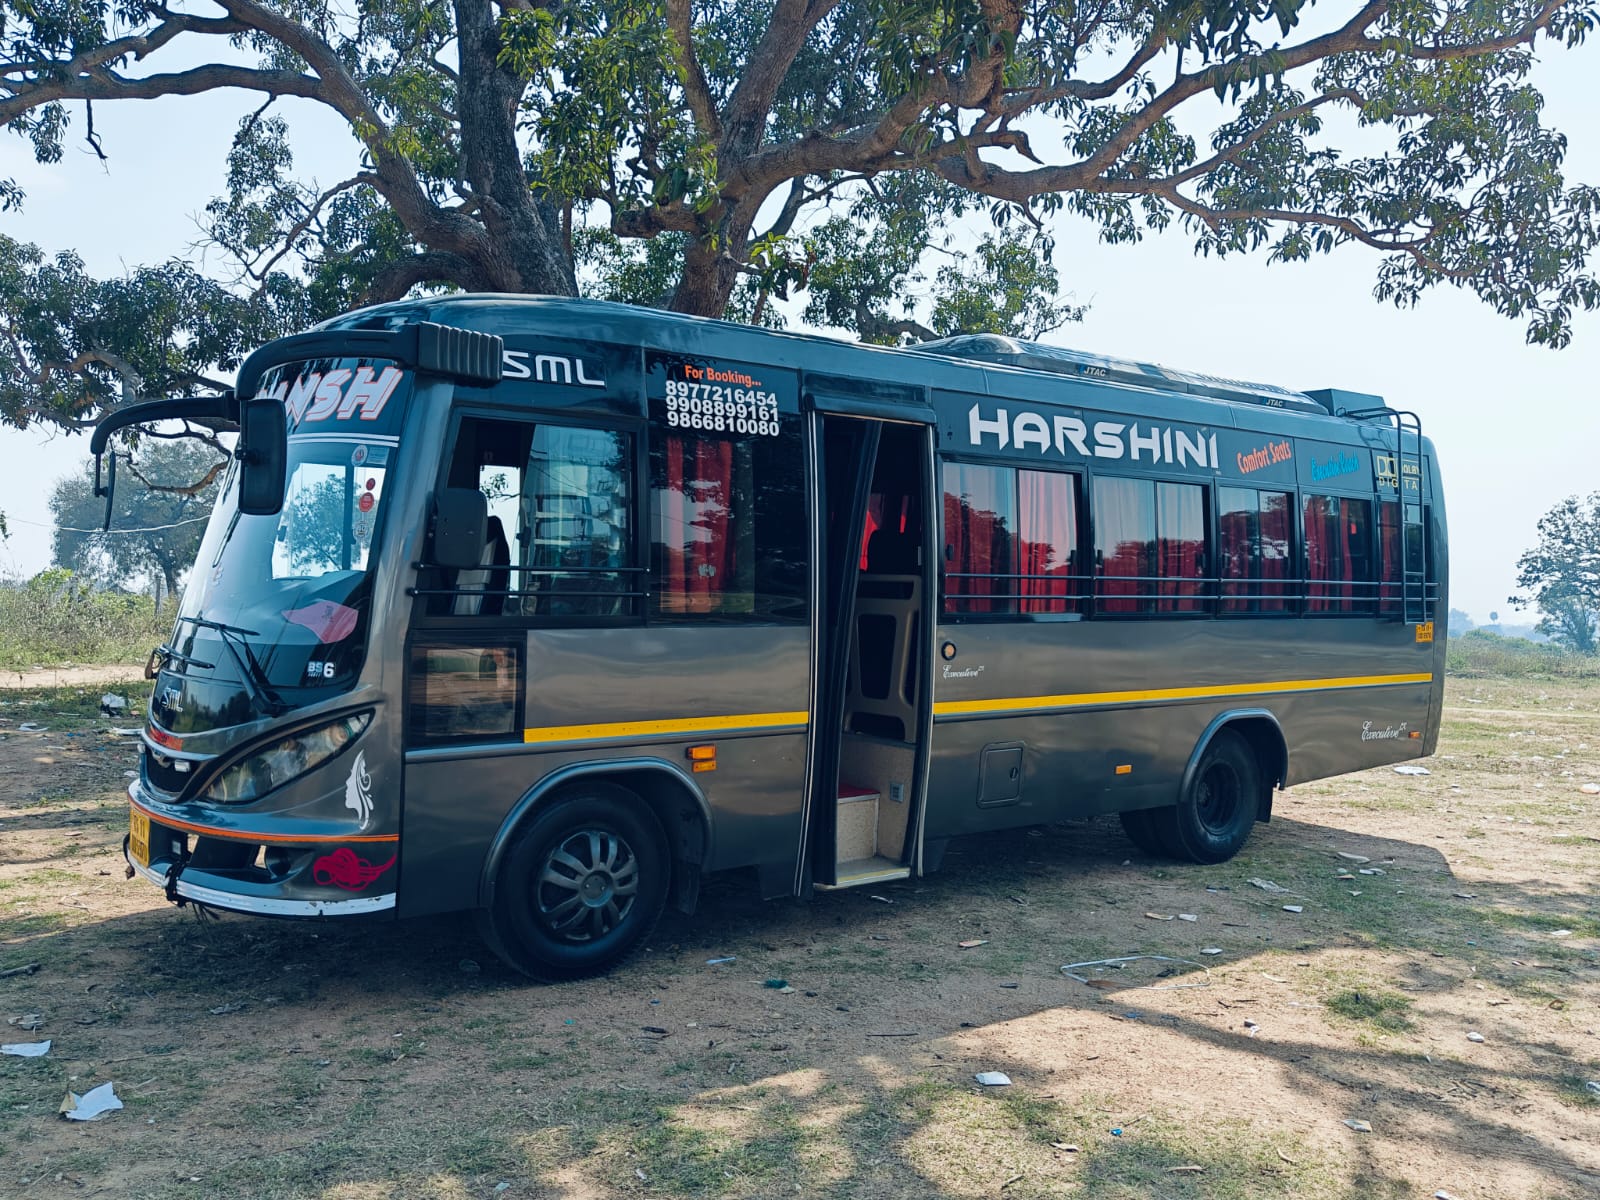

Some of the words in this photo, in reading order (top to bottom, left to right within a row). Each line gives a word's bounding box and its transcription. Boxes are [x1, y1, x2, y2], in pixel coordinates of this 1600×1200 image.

[684, 365, 704, 380] For
[706, 367, 762, 388] Booking...
[1084, 366, 1106, 377] JTAC
[665, 380, 778, 408] 8977216454
[1265, 398, 1284, 408] JTAC
[666, 395, 779, 422] 9908899161
[667, 412, 780, 437] 9866810080
[968, 402, 1219, 469] HARSHINI
[1236, 448, 1270, 475] Comfort
[1269, 440, 1293, 465] Seats
[1361, 720, 1399, 742] Executive
